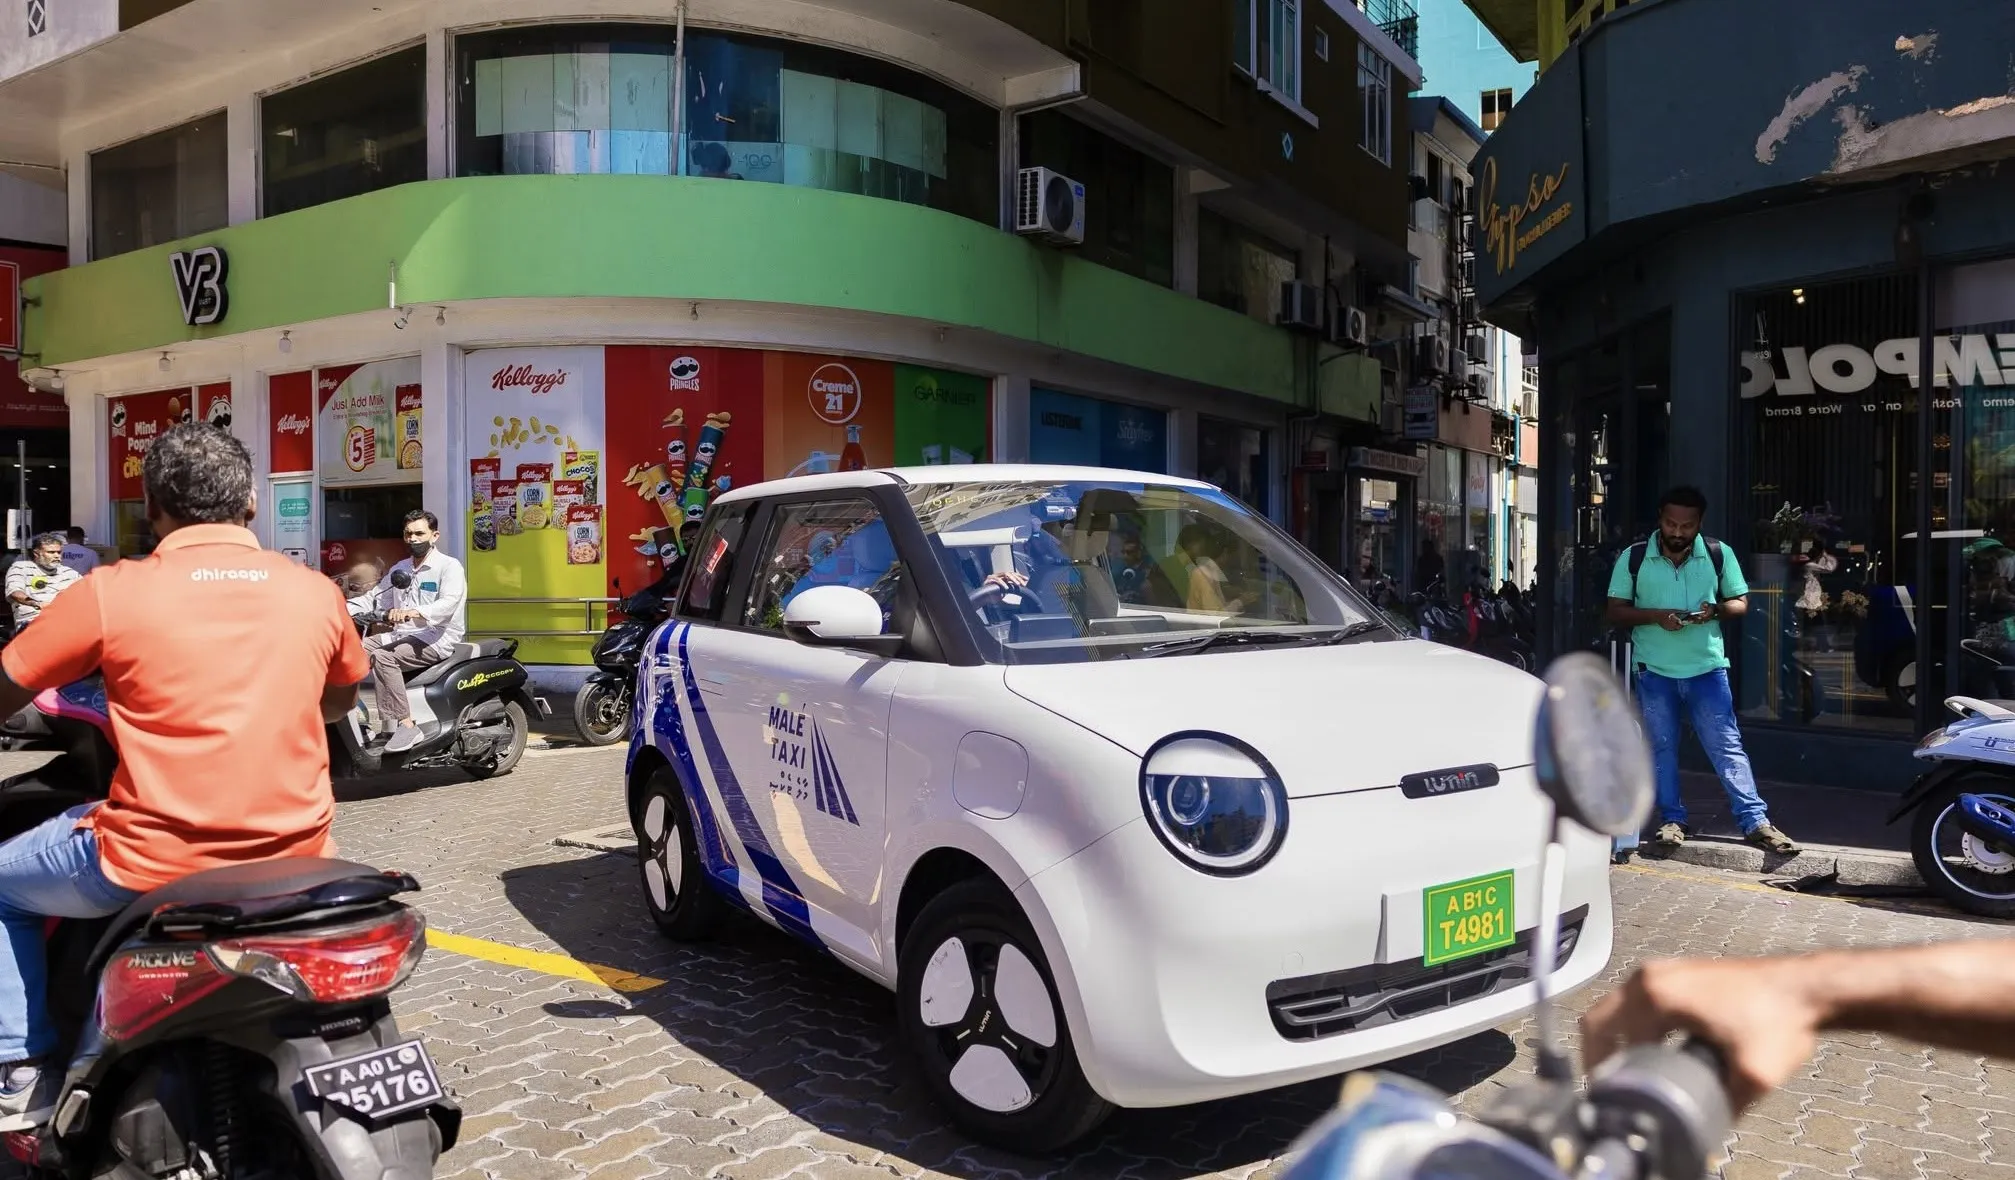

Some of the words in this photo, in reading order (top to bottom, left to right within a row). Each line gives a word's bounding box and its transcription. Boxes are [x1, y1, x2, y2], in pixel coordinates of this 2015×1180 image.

[169, 247, 221, 325] VB
[492, 364, 568, 394] Kellogg's
[670, 377, 700, 391] PRINGLES
[813, 379, 853, 394] Creme
[331, 399, 348, 411] Just
[350, 397, 367, 409] Add
[368, 394, 385, 407] Milk
[825, 393, 843, 410] 21
[914, 385, 976, 407] GARNIER
[134, 420, 157, 436] Mind
[277, 414, 311, 435] Kellogg's
[352, 437, 363, 463] 5
[190, 567, 269, 582] dhiraagu
[768, 703, 806, 738] MALÉ
[770, 737, 806, 770] TAXI
[1439, 907, 1505, 951] T4981
[320, 1016, 362, 1032] HONDA
